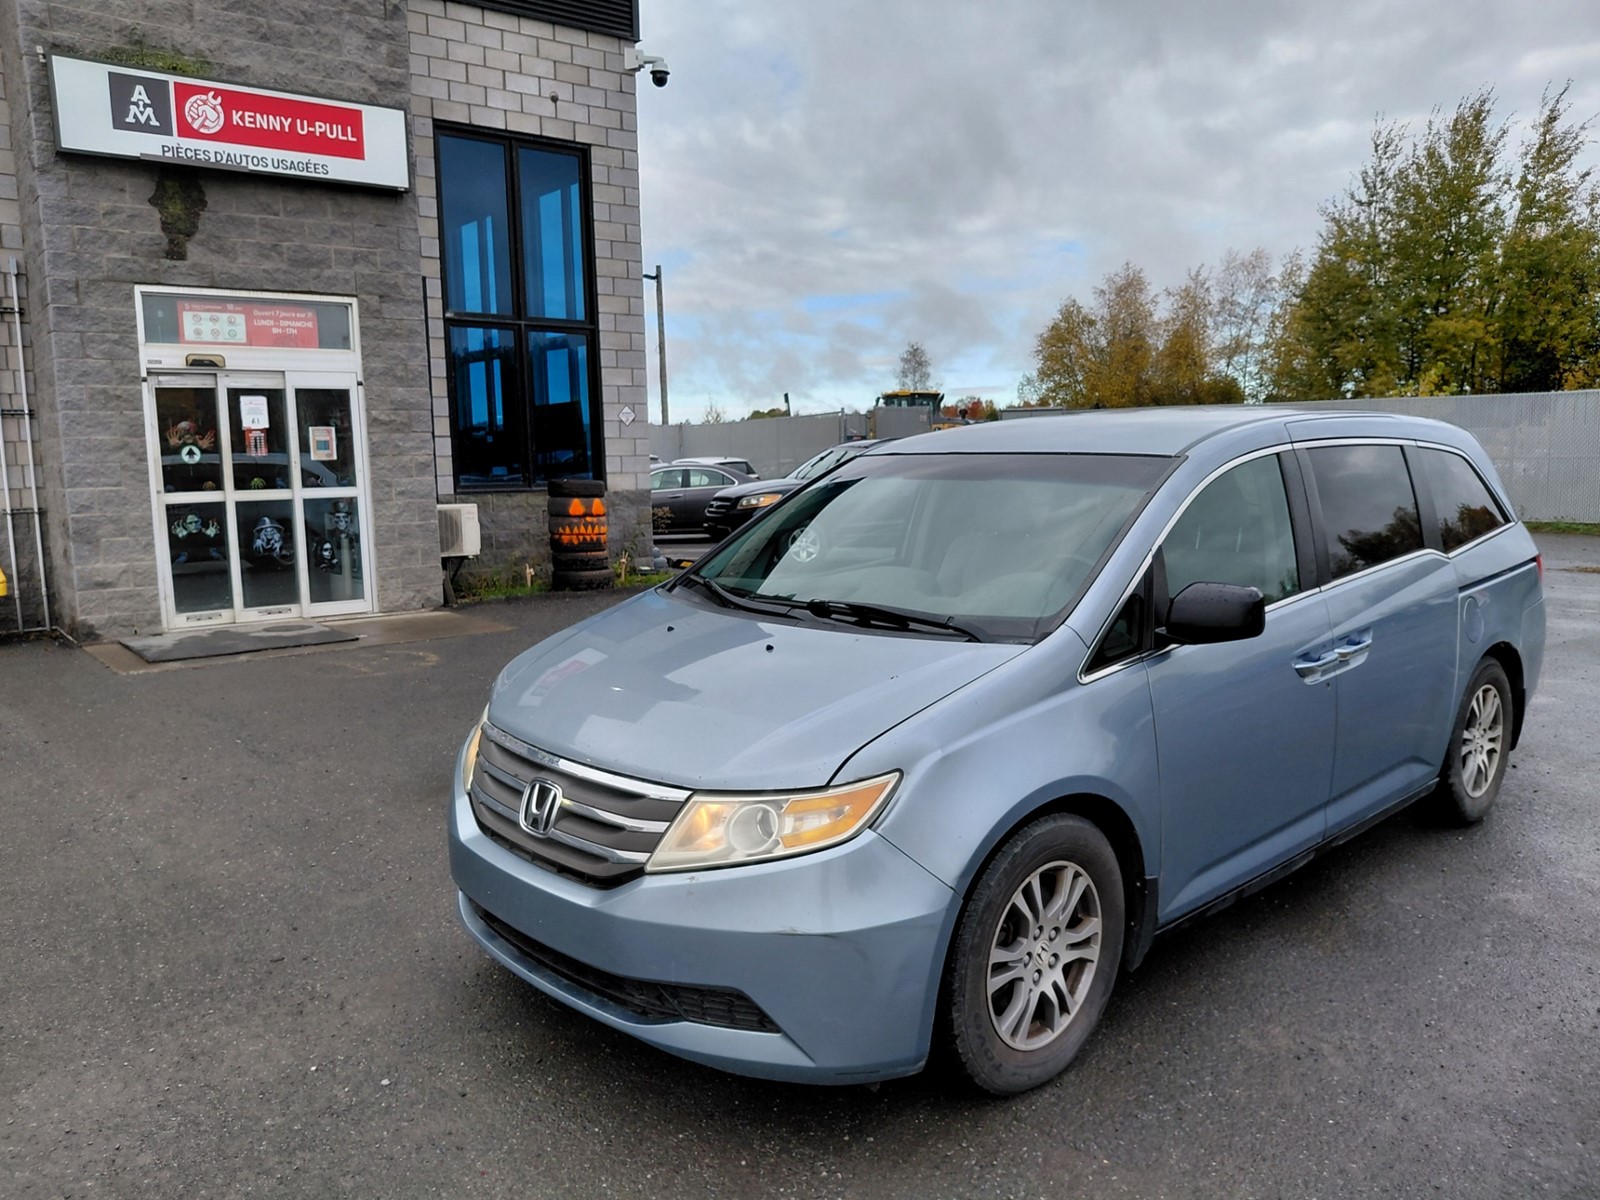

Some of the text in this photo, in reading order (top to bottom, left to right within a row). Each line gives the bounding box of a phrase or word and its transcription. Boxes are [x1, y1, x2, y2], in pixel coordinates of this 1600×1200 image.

[232, 109, 358, 142] KENNY U-PULL
[161, 143, 329, 175] PIÈCES D'AUTOS USAGÉES
[280, 320, 313, 328] DIMANCHE
